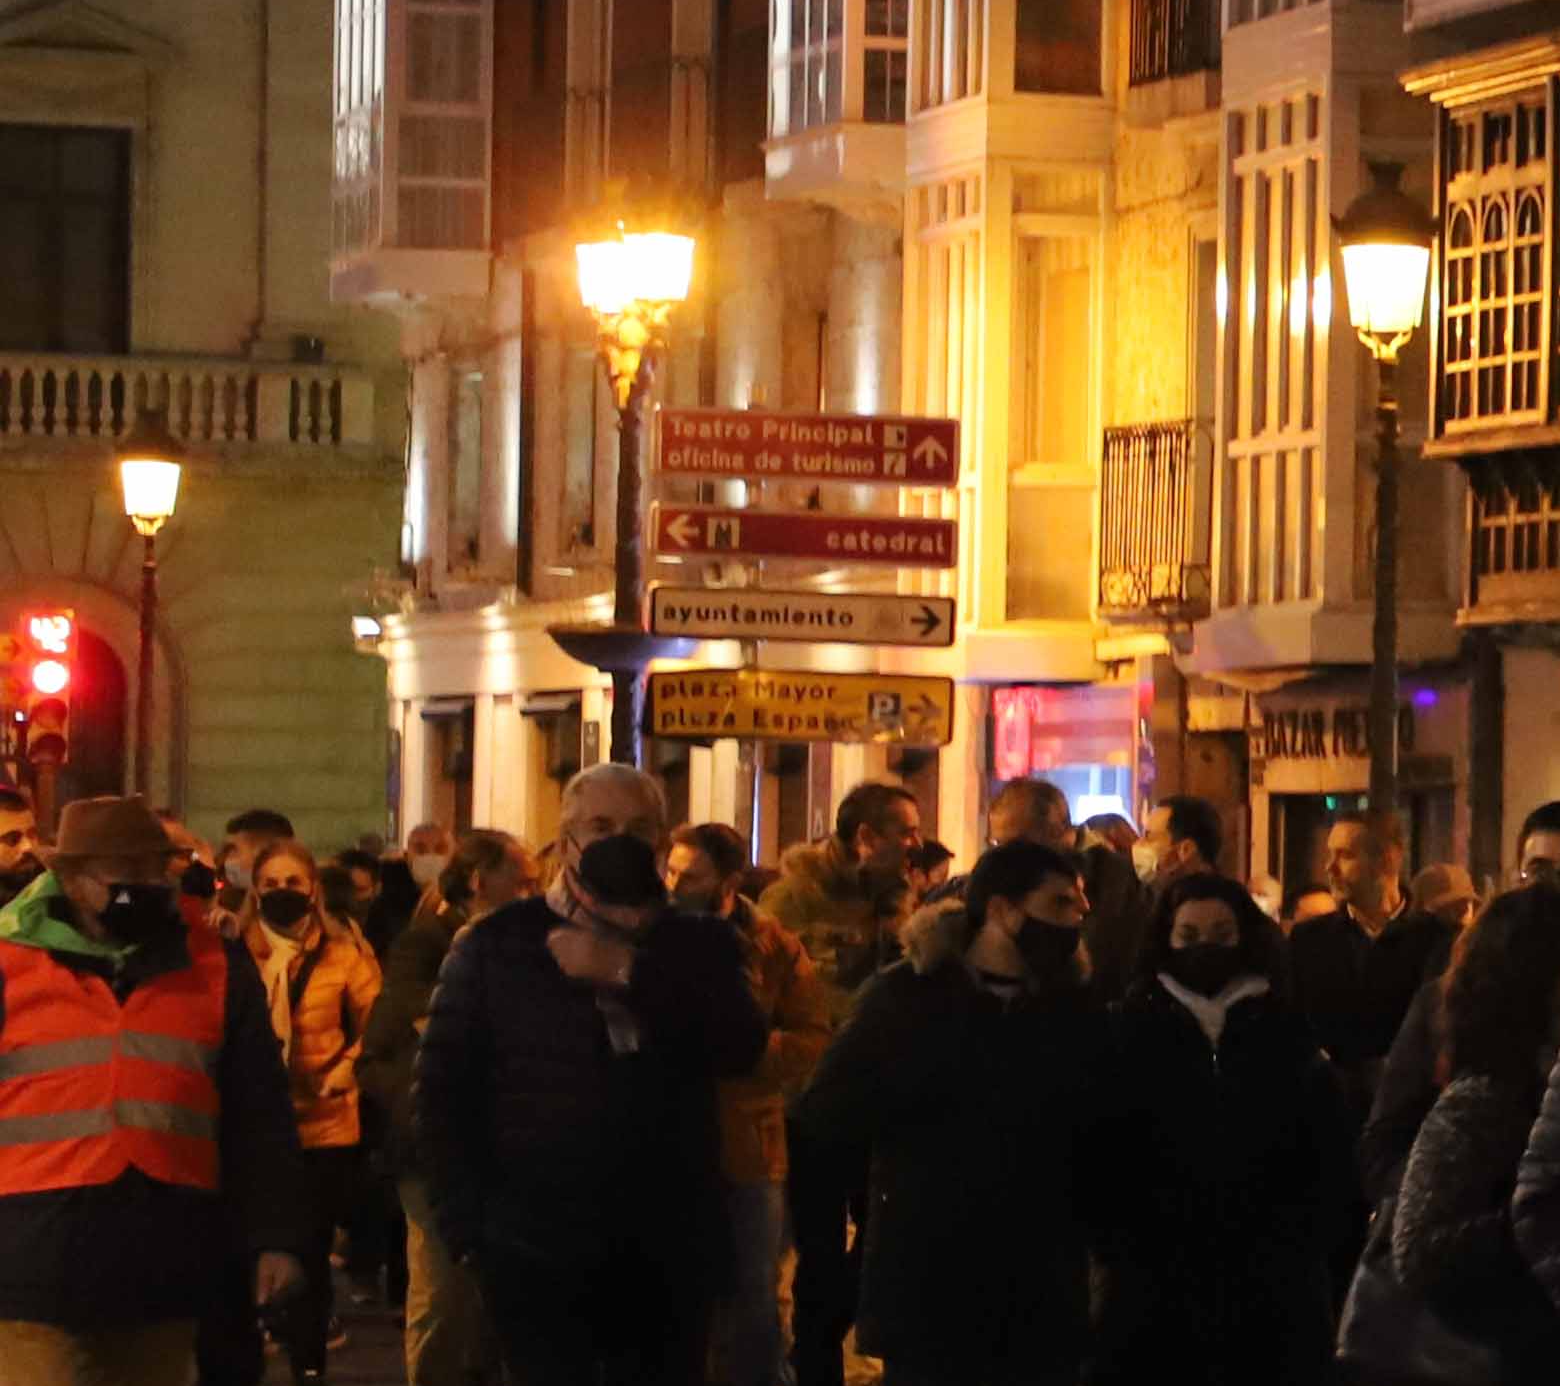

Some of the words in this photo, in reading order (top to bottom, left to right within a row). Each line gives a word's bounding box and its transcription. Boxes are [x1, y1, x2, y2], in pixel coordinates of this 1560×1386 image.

[668, 416, 750, 439] Teatro
[762, 418, 875, 447] Principal
[668, 447, 744, 470] oficina
[755, 450, 782, 471] de
[792, 451, 875, 474] turismo
[827, 529, 945, 554] catedral
[663, 603, 854, 626] ayuntamiento
[754, 678, 837, 702] Mayor
